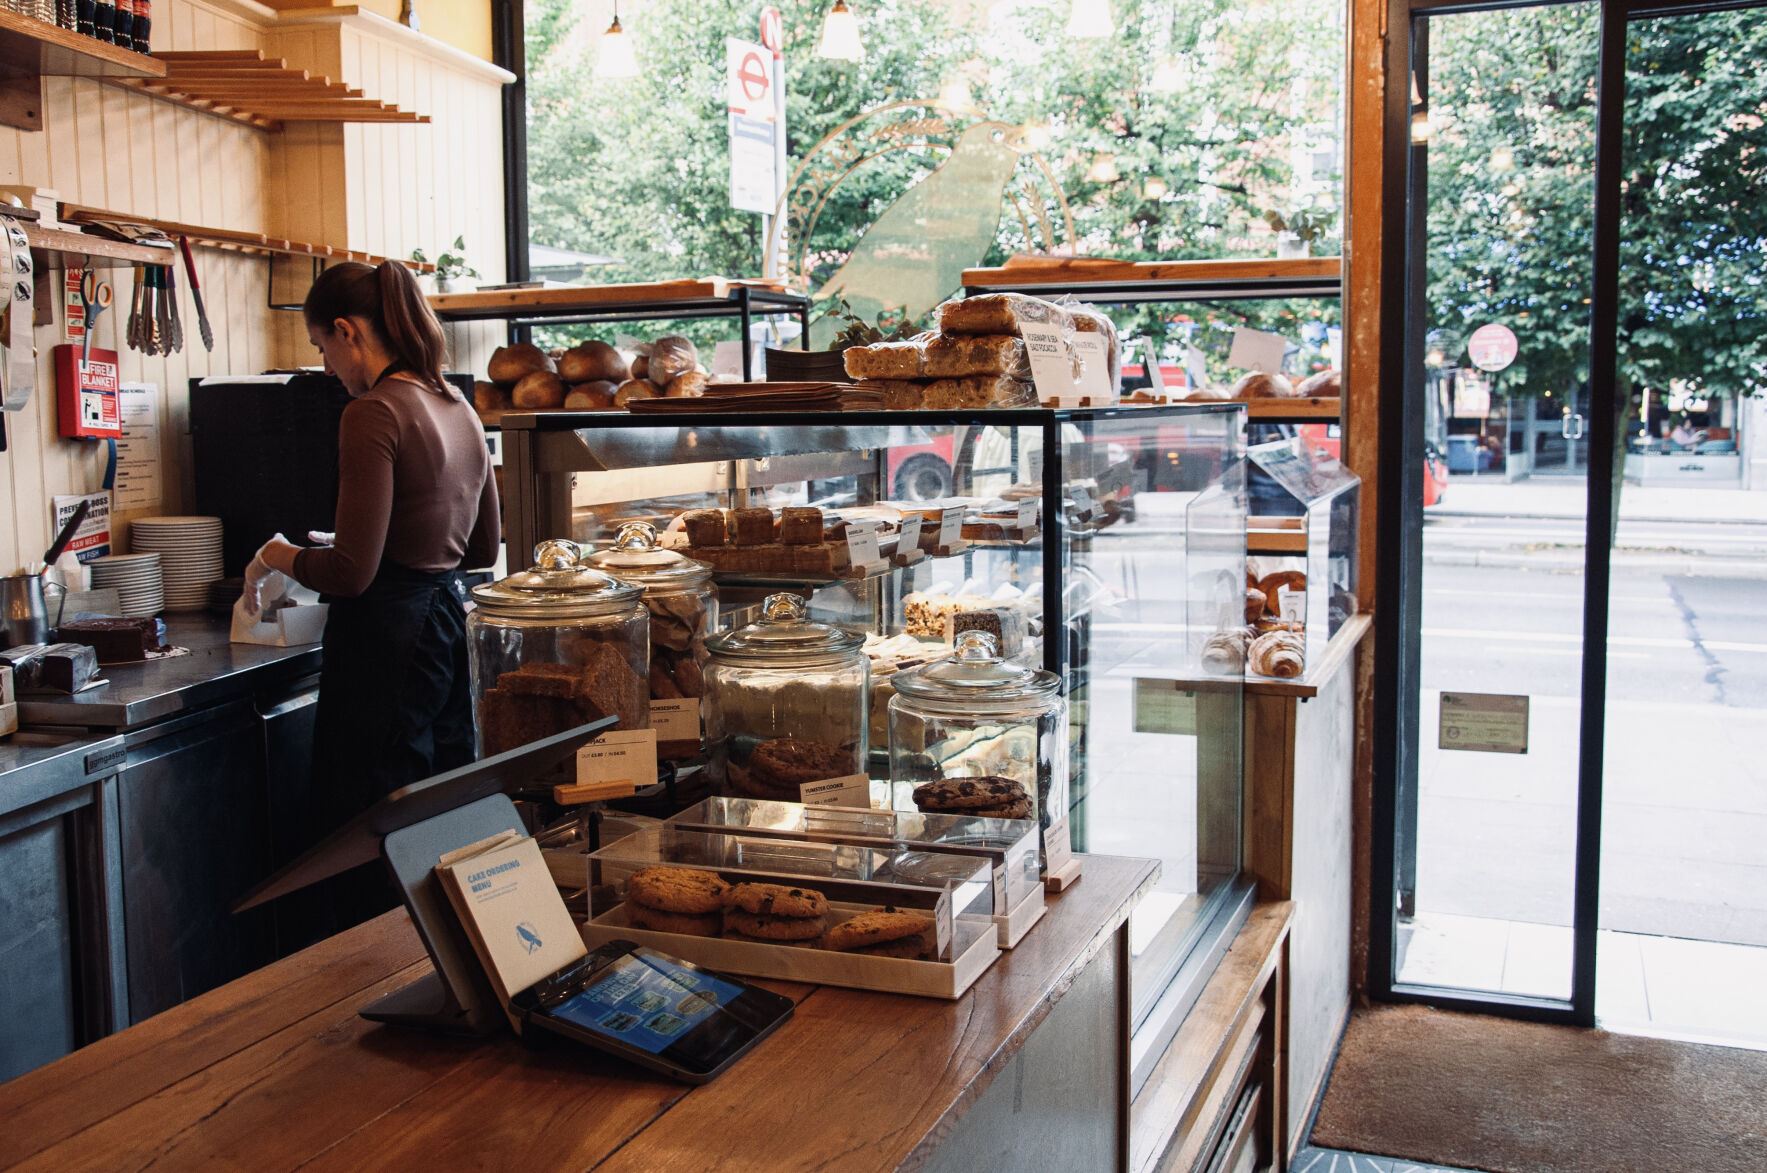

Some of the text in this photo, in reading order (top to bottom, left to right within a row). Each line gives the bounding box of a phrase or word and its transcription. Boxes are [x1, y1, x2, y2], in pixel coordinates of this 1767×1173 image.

[766, 12, 782, 50] N
[90, 364, 107, 377] FIRE
[81, 373, 114, 388] BLANKET
[91, 496, 108, 508] ROSS
[71, 535, 100, 549] RAW MEAT
[78, 549, 100, 560] AW FISH
[89, 750, 126, 770] ggmgastro
[805, 782, 844, 794] YUMSTER COOKIE
[467, 859, 521, 884] CAKE ORDERING
[471, 879, 492, 893] MENU
